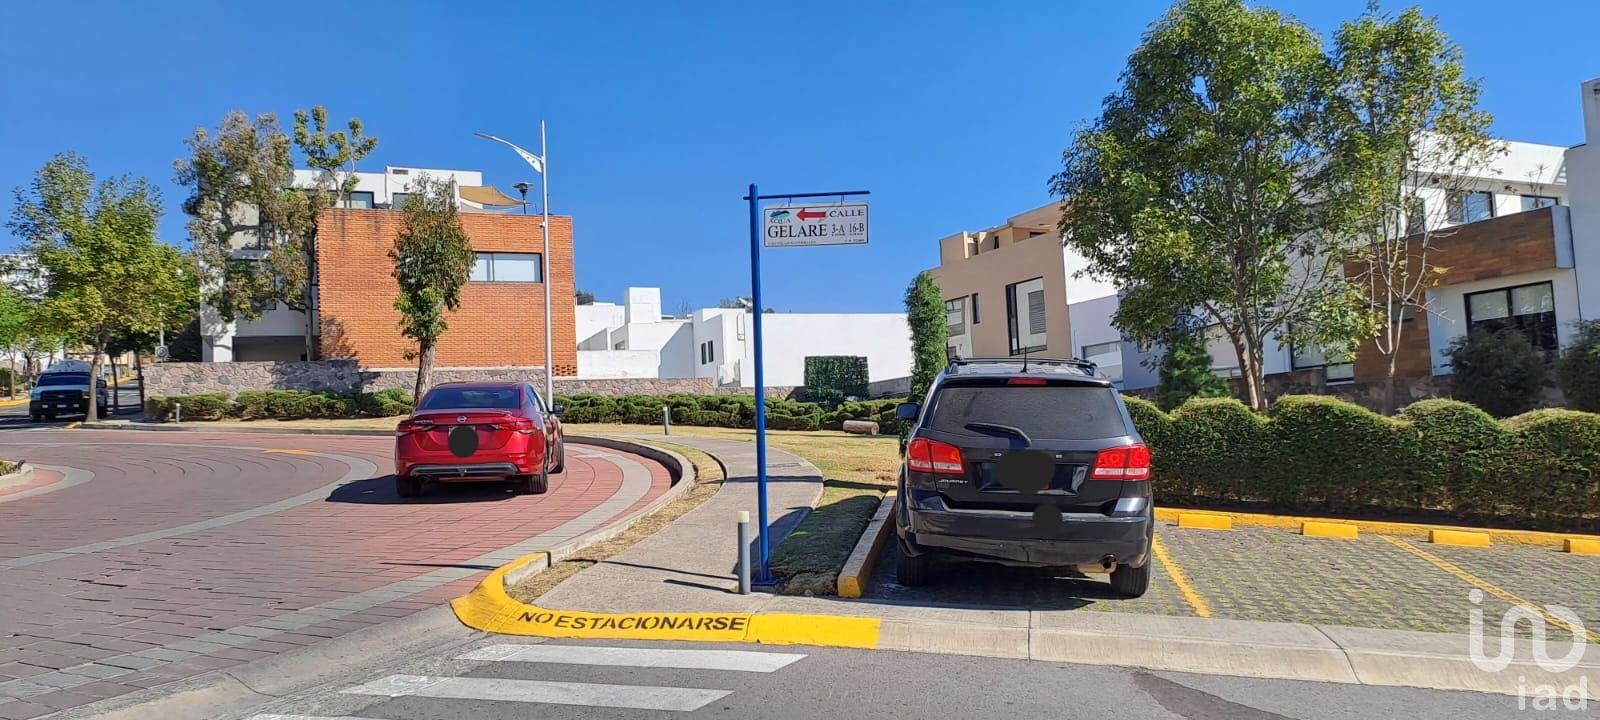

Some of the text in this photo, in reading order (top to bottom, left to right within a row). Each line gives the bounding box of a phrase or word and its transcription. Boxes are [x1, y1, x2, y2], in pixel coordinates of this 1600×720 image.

[829, 209, 865, 217] CALLE
[767, 222, 865, 238] GELARE 3-A 16-B
[517, 611, 747, 631] NO ESTACIONARSE
